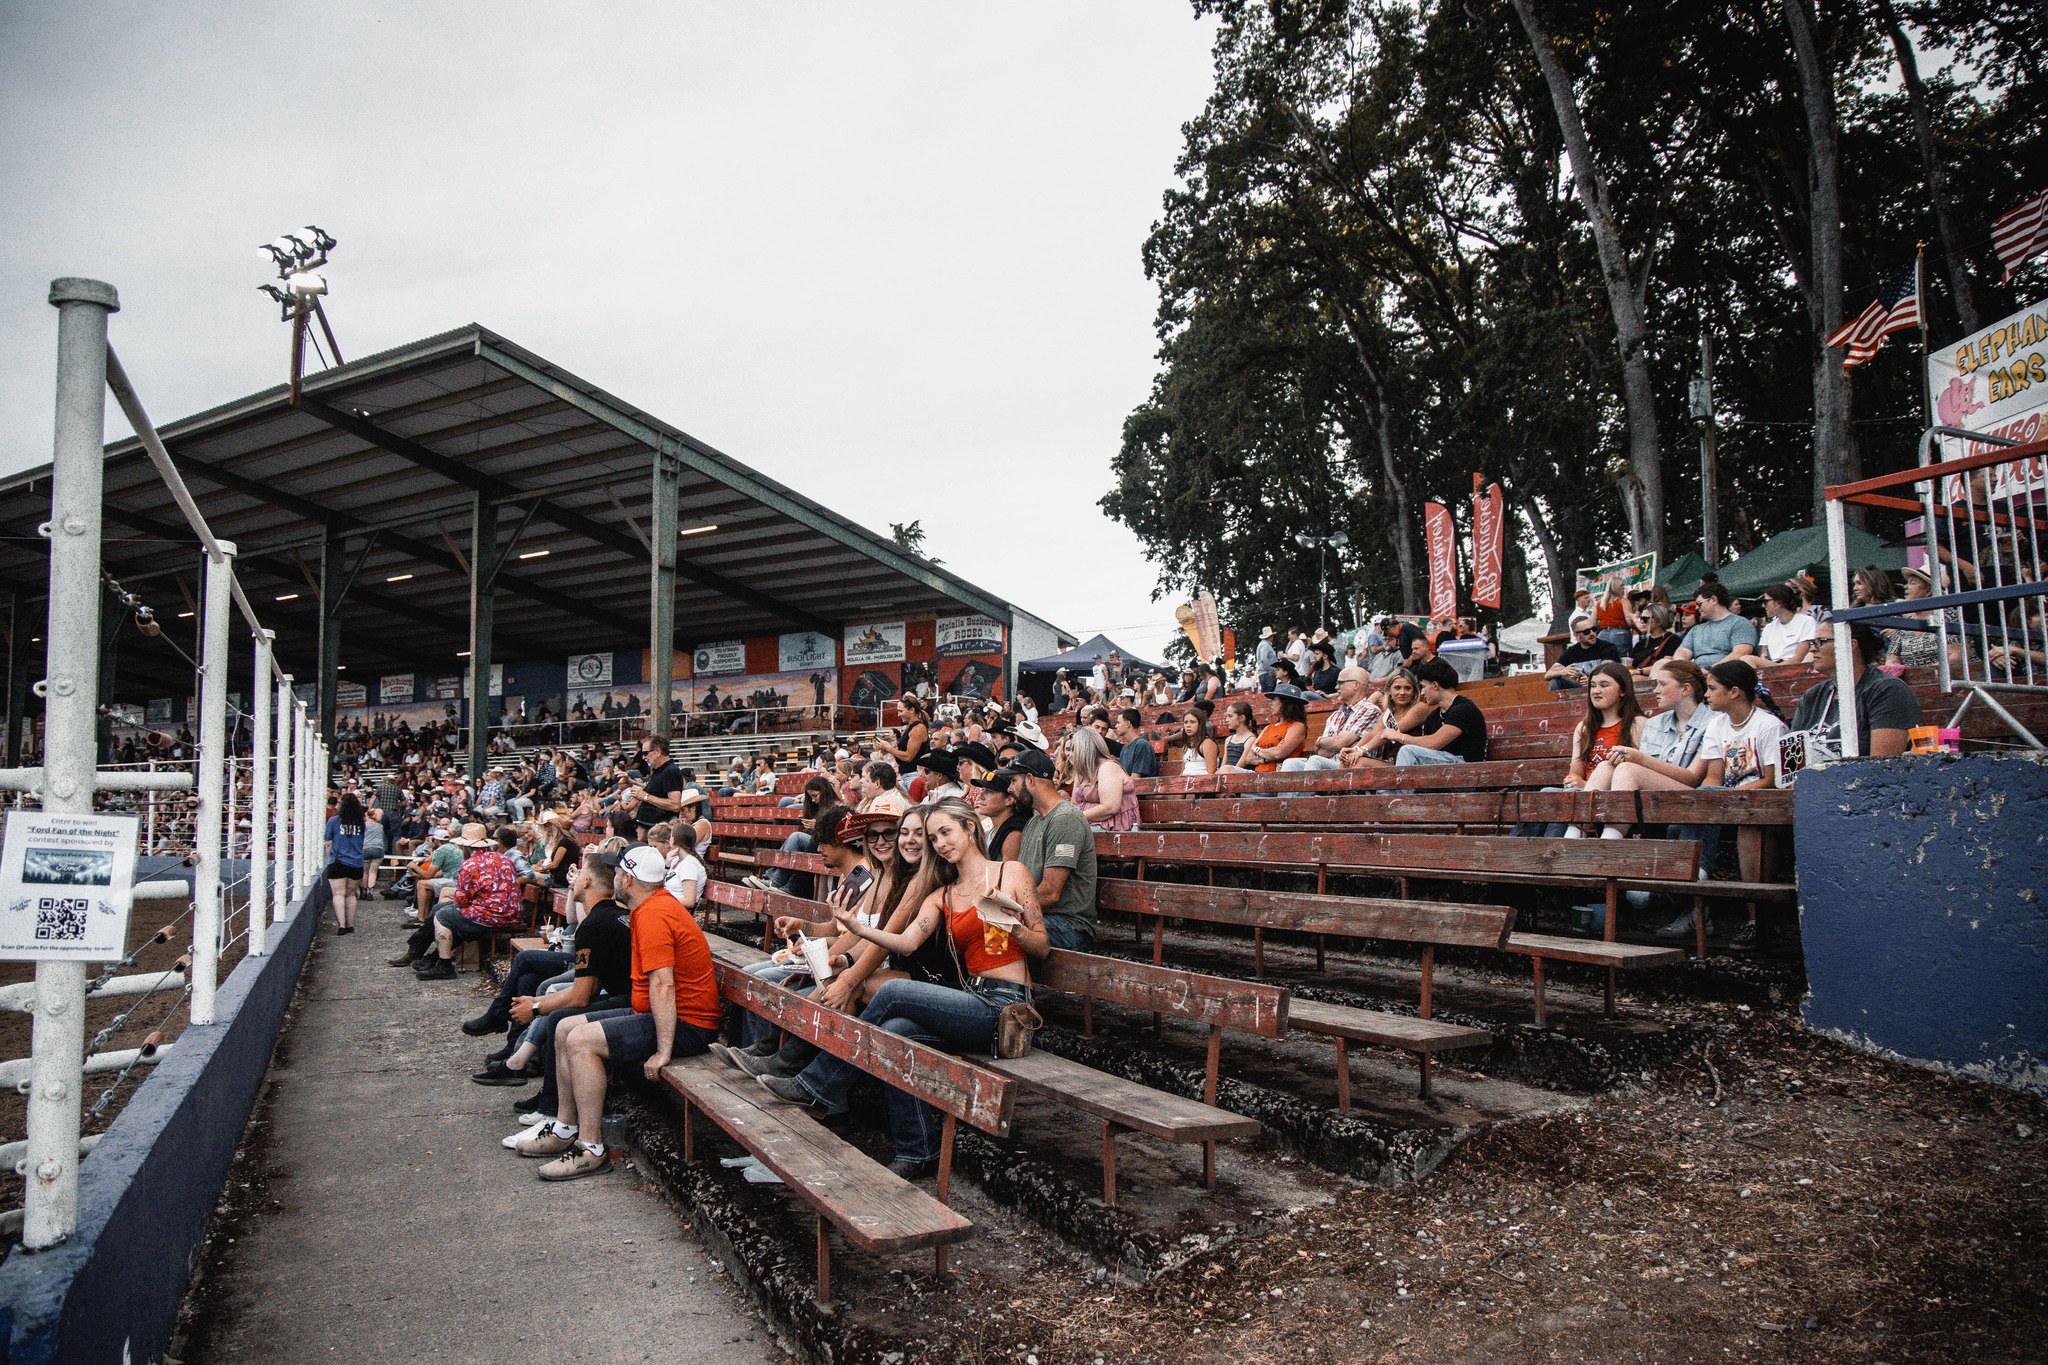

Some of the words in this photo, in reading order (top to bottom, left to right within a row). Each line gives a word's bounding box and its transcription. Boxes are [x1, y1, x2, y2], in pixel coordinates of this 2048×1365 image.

[1988, 353, 2046, 404] EARS
[954, 628, 983, 640] RODEO
[787, 654, 804, 663] BUSCH
[806, 653, 826, 661] LIGHT
[1539, 719, 1549, 733] 9
[1779, 733, 1804, 748] 99.5
[52, 827, 68, 835] Fan
[68, 828, 78, 836] of
[79, 828, 94, 836] the
[28, 836, 59, 844] contest
[60, 837, 103, 846] sponsored
[104, 838, 115, 847] by
[55, 863, 81, 872] Ford
[625, 859, 637, 869] 5
[1172, 979, 1189, 1013] 2
[746, 980, 753, 1001] 6
[812, 1010, 821, 1041] 4
[851, 1029, 862, 1060] 3
[902, 1048, 915, 1087] 2
